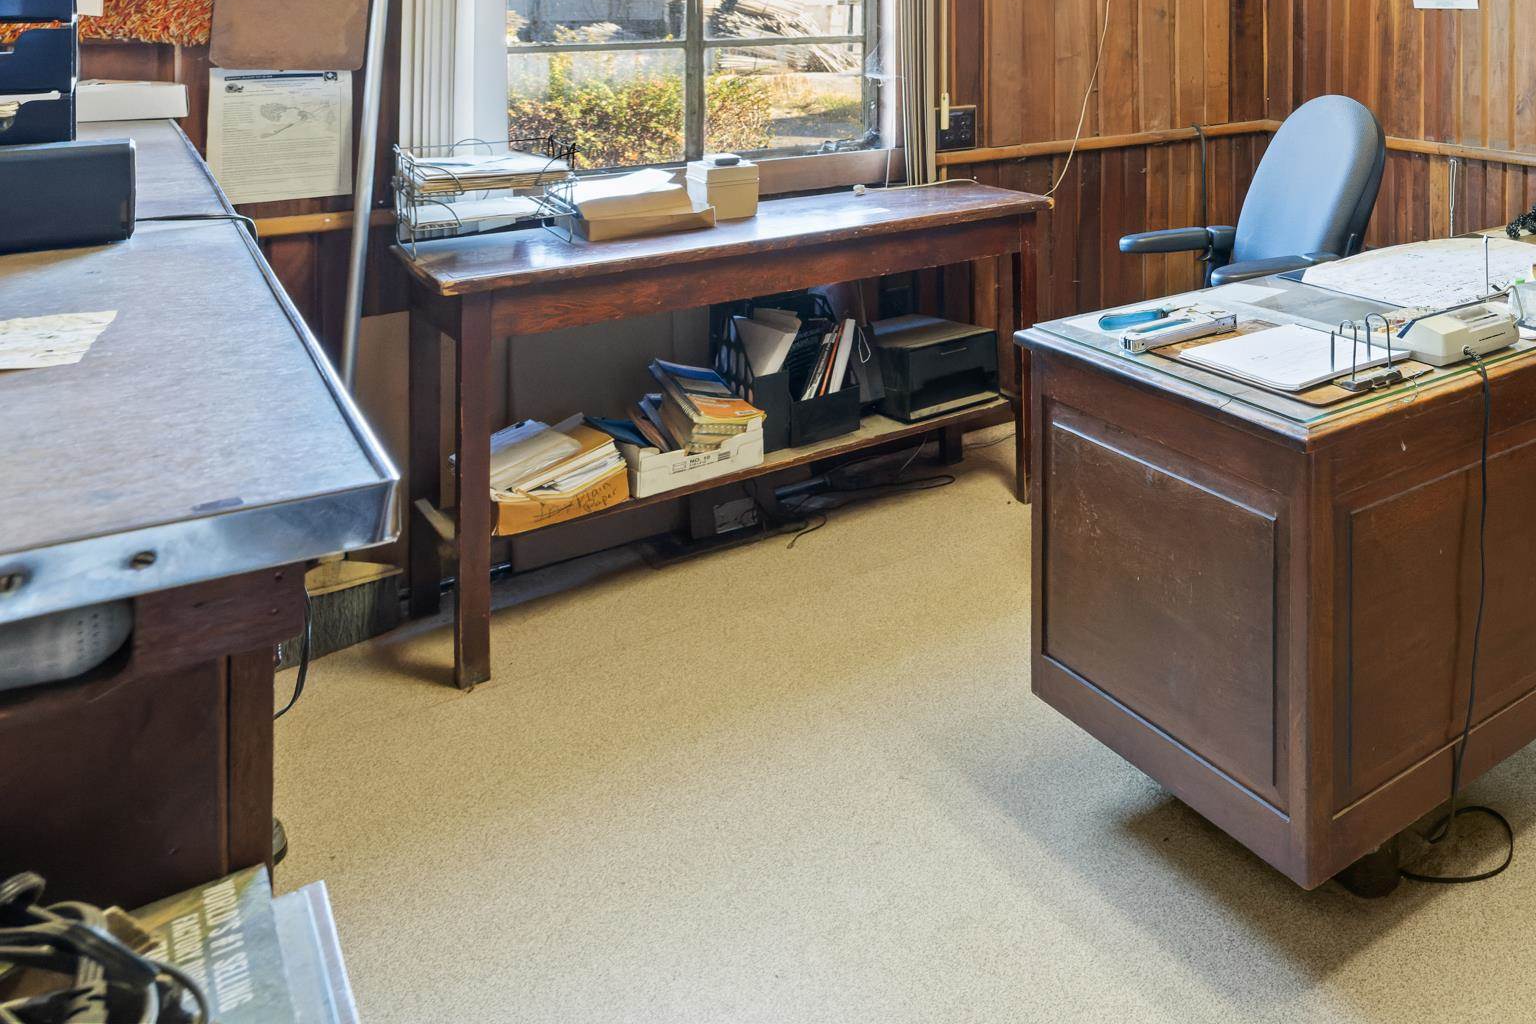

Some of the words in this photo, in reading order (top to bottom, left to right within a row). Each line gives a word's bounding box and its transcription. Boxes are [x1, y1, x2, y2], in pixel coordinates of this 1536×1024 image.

[202, 878, 242, 939] WORLD'S
[170, 912, 204, 964] FACTORY
[209, 932, 245, 958] #1
[212, 951, 255, 1013] SELLING
